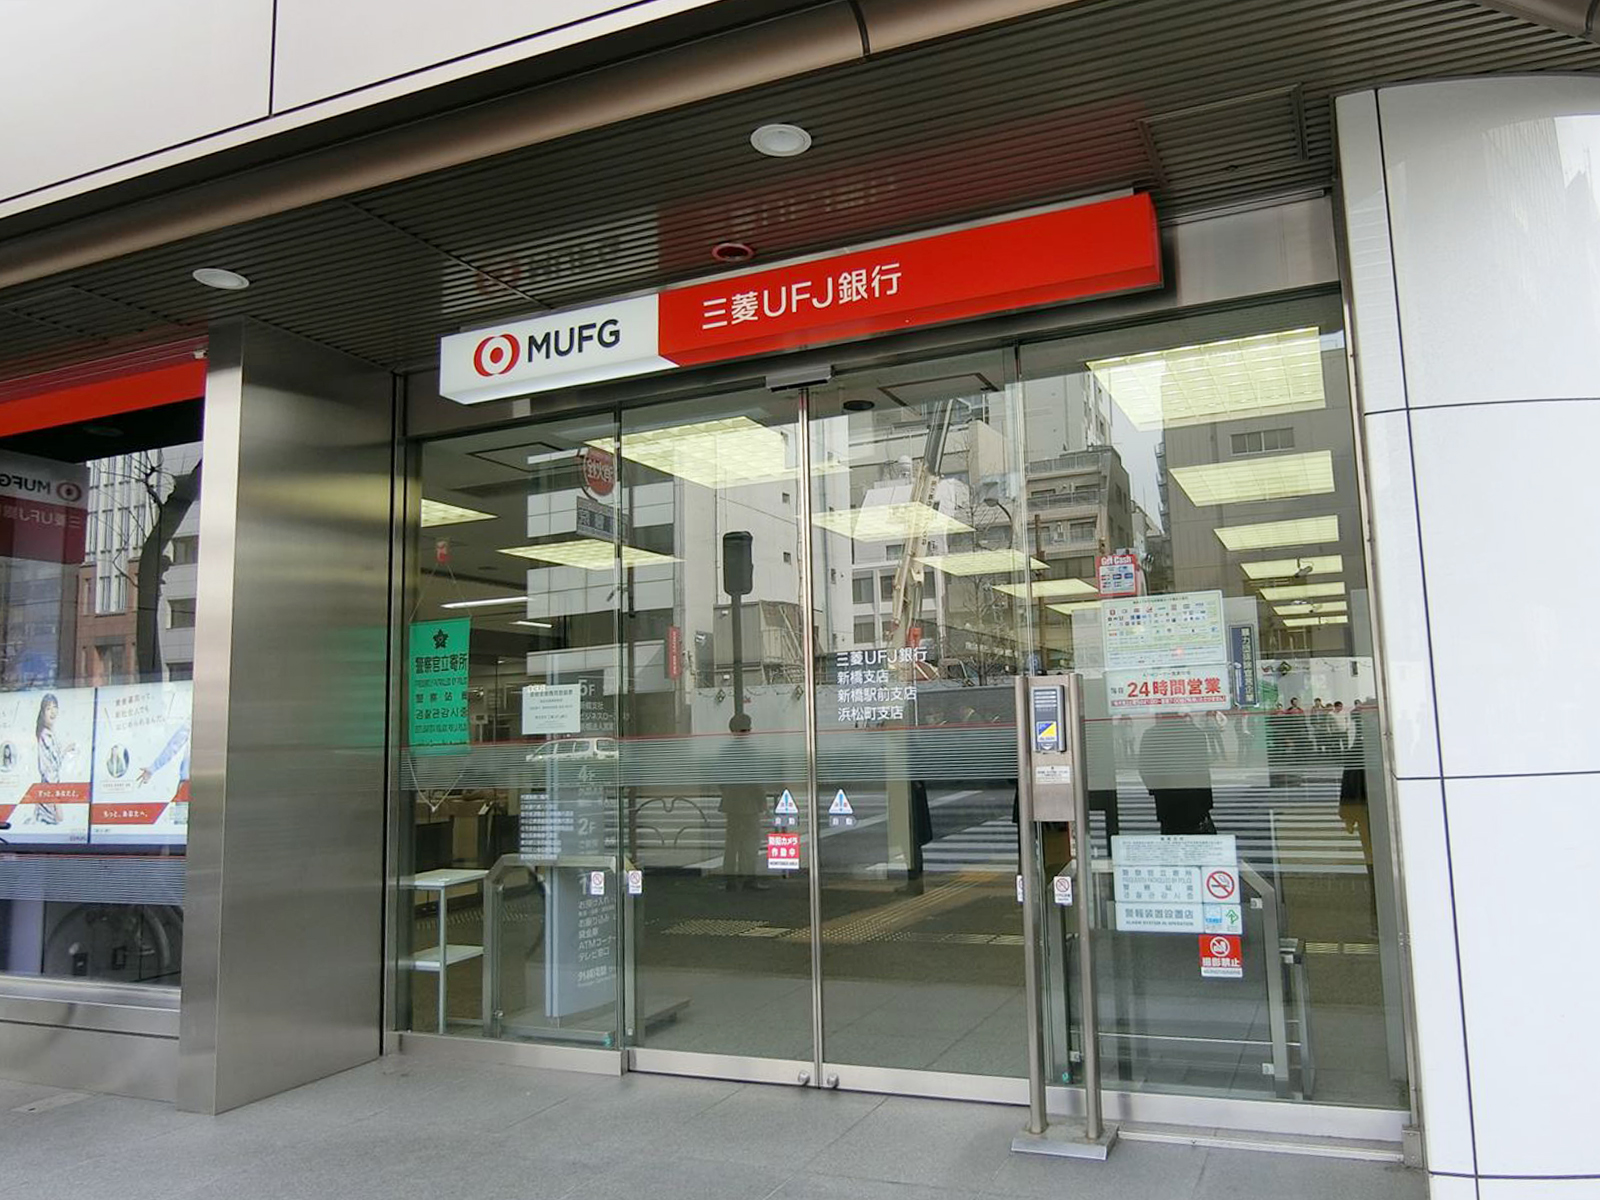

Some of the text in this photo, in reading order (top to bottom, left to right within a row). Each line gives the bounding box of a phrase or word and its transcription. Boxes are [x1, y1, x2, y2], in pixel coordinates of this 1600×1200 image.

[702, 263, 902, 330] 三菱UFJ銀行
[527, 318, 620, 363] MUFG
[836, 647, 927, 668] 三菱UFJ銀行
[837, 669, 889, 685] 新橋支店
[1127, 677, 1220, 697] 24時間営業
[837, 687, 917, 703] 新橋駅前支店
[838, 706, 904, 722] 浜松町支店
